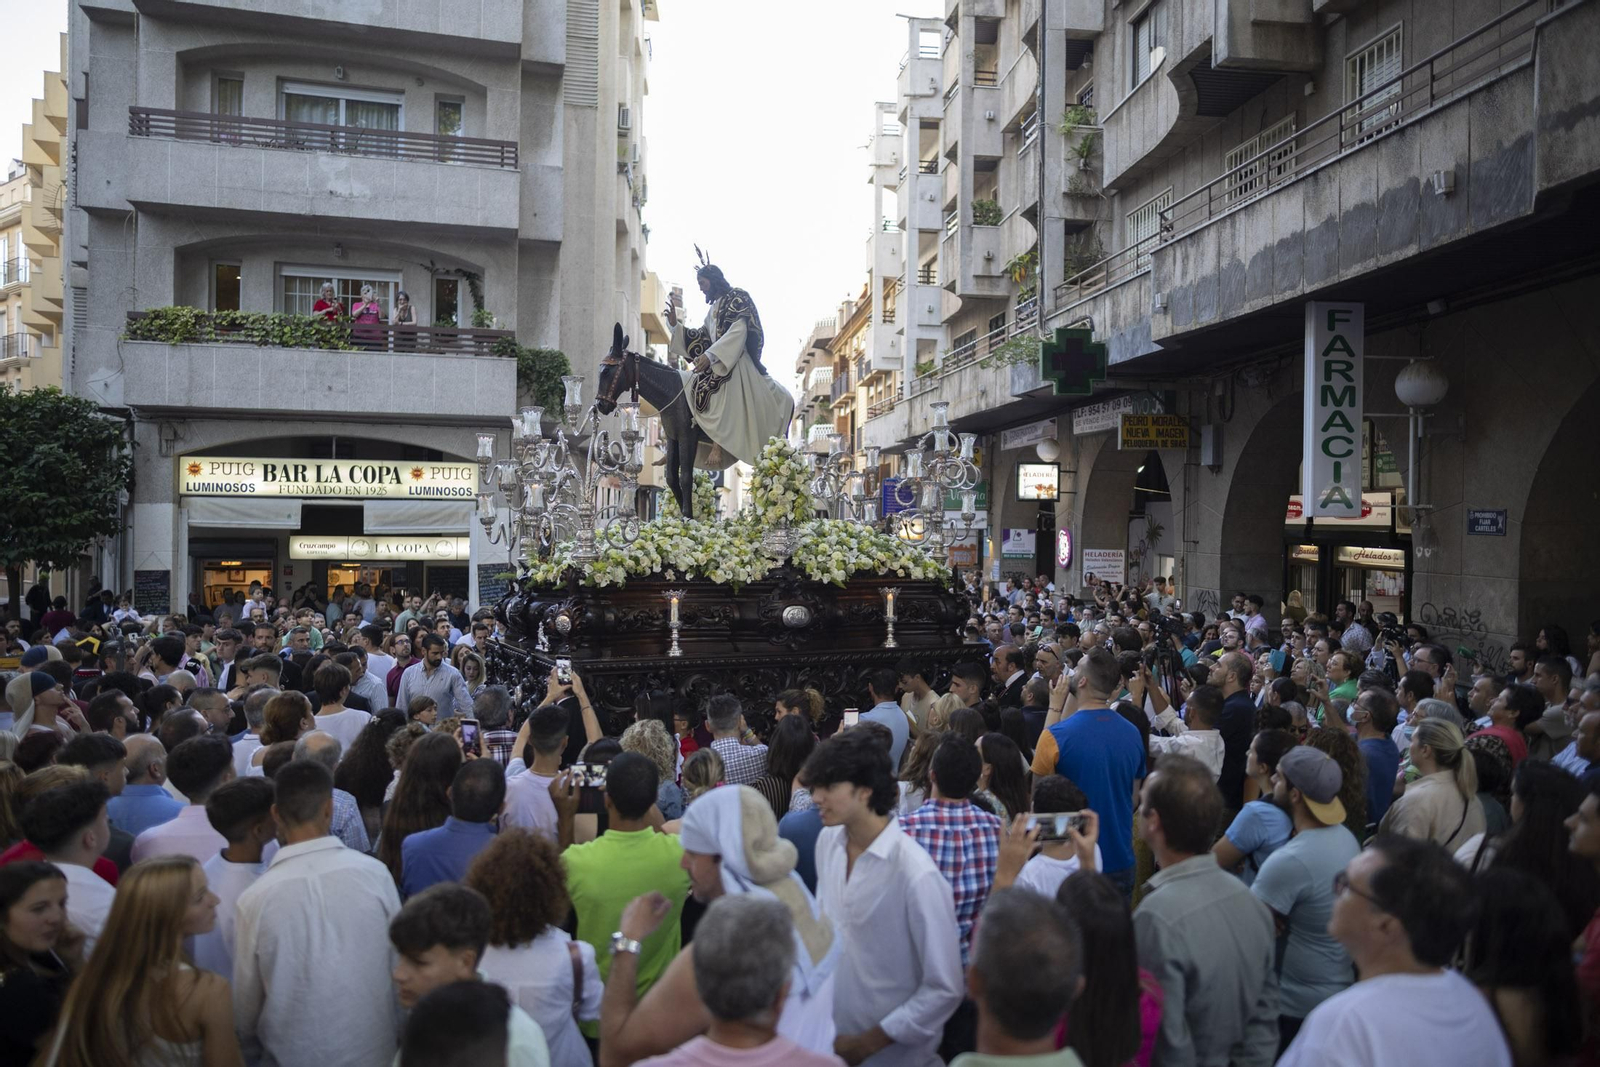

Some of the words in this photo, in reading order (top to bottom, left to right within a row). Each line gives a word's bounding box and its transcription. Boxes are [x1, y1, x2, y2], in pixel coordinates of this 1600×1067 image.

[1088, 405, 1101, 416] 954
[1102, 403, 1111, 414] 57
[1112, 400, 1122, 411] 09
[1319, 309, 1357, 510] FARMACIA
[1082, 416, 1100, 425] VENDE
[1124, 416, 1148, 426] PEDRO
[1152, 416, 1188, 427] MORALES
[1126, 428, 1150, 438] NUEVA
[1156, 428, 1184, 439] IMAGEN
[1161, 439, 1168, 448] DE
[208, 461, 256, 476] PUIG
[430, 466, 473, 480] PUIG
[262, 463, 309, 484] BAR
[314, 464, 342, 484] LA
[348, 465, 403, 486] COPA
[186, 482, 256, 494] LUMINOSOS
[279, 484, 342, 495] FUNDADO
[344, 486, 361, 496] EN
[409, 486, 473, 497] LUMINOSOS
[1474, 511, 1497, 519] PROHIBIDO
[299, 542, 336, 551] Cruzcampo
[375, 543, 391, 554] LA
[395, 543, 431, 555] COPA
[1353, 550, 1392, 561] Helados
